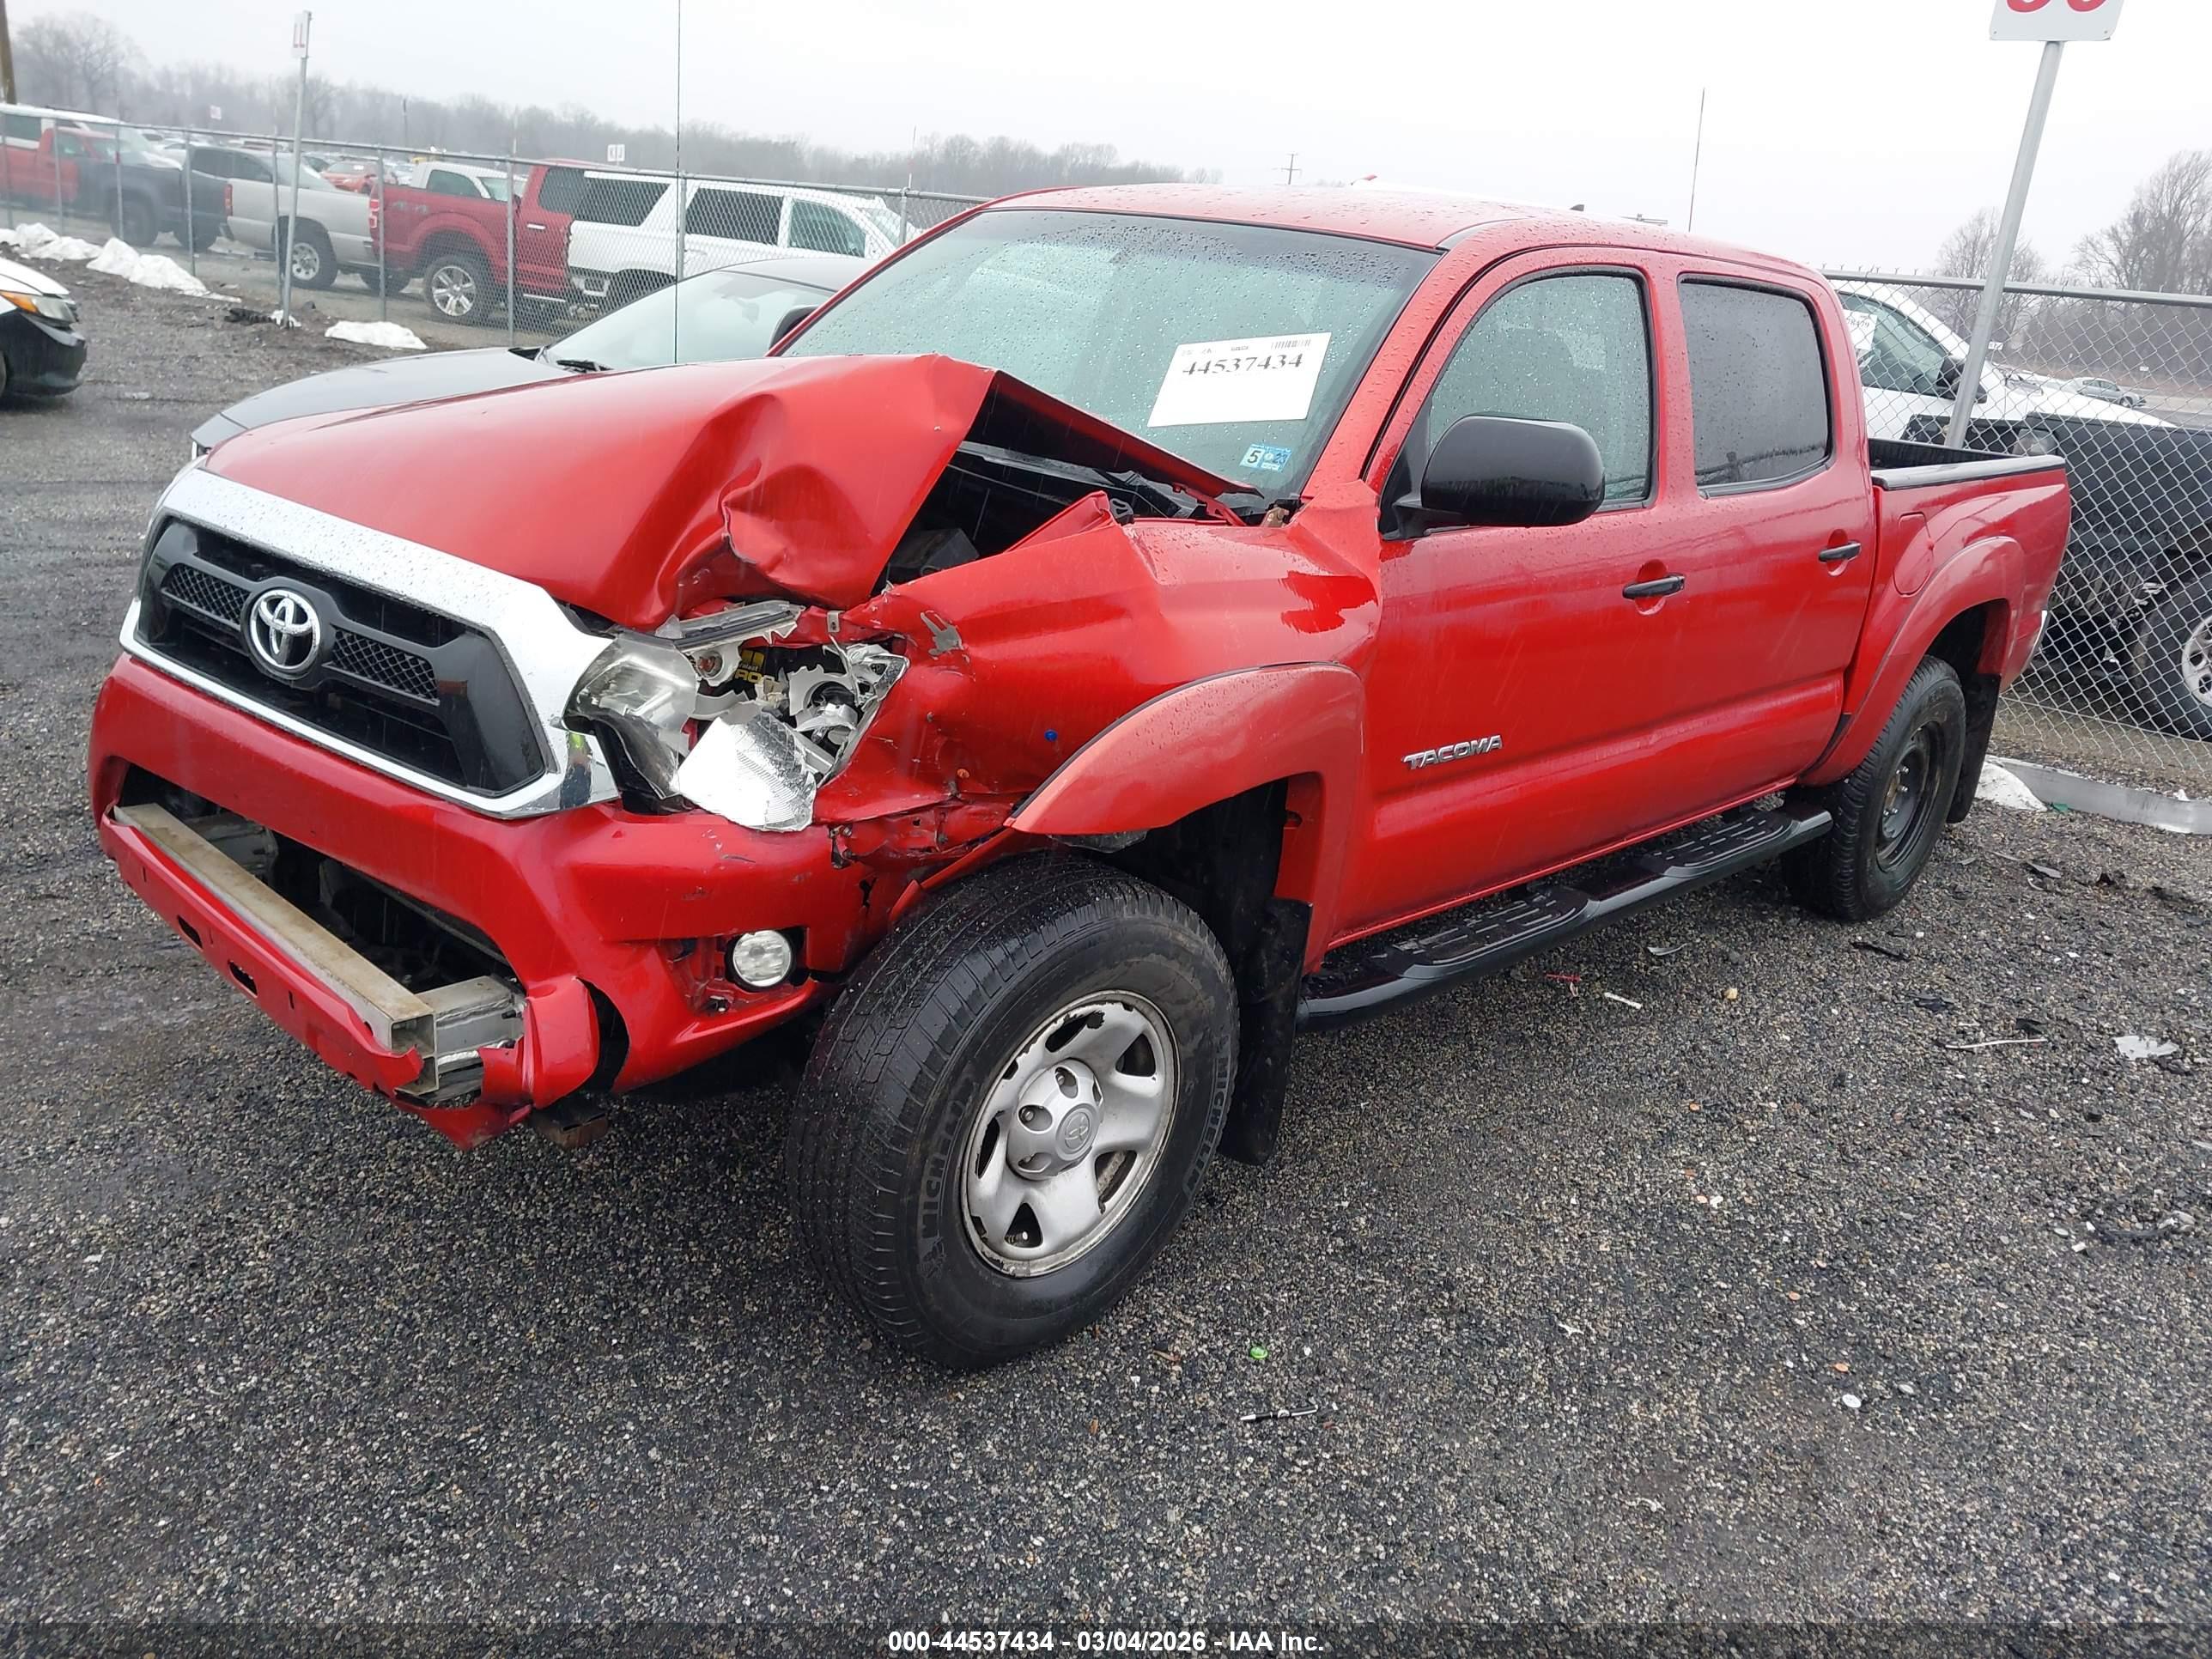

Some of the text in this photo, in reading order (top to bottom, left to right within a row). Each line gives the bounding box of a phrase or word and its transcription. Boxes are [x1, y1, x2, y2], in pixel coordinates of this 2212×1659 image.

[1182, 353, 1304, 375] 44537434
[1247, 450, 1261, 463] 5
[1401, 734, 1504, 769] TACOMA
